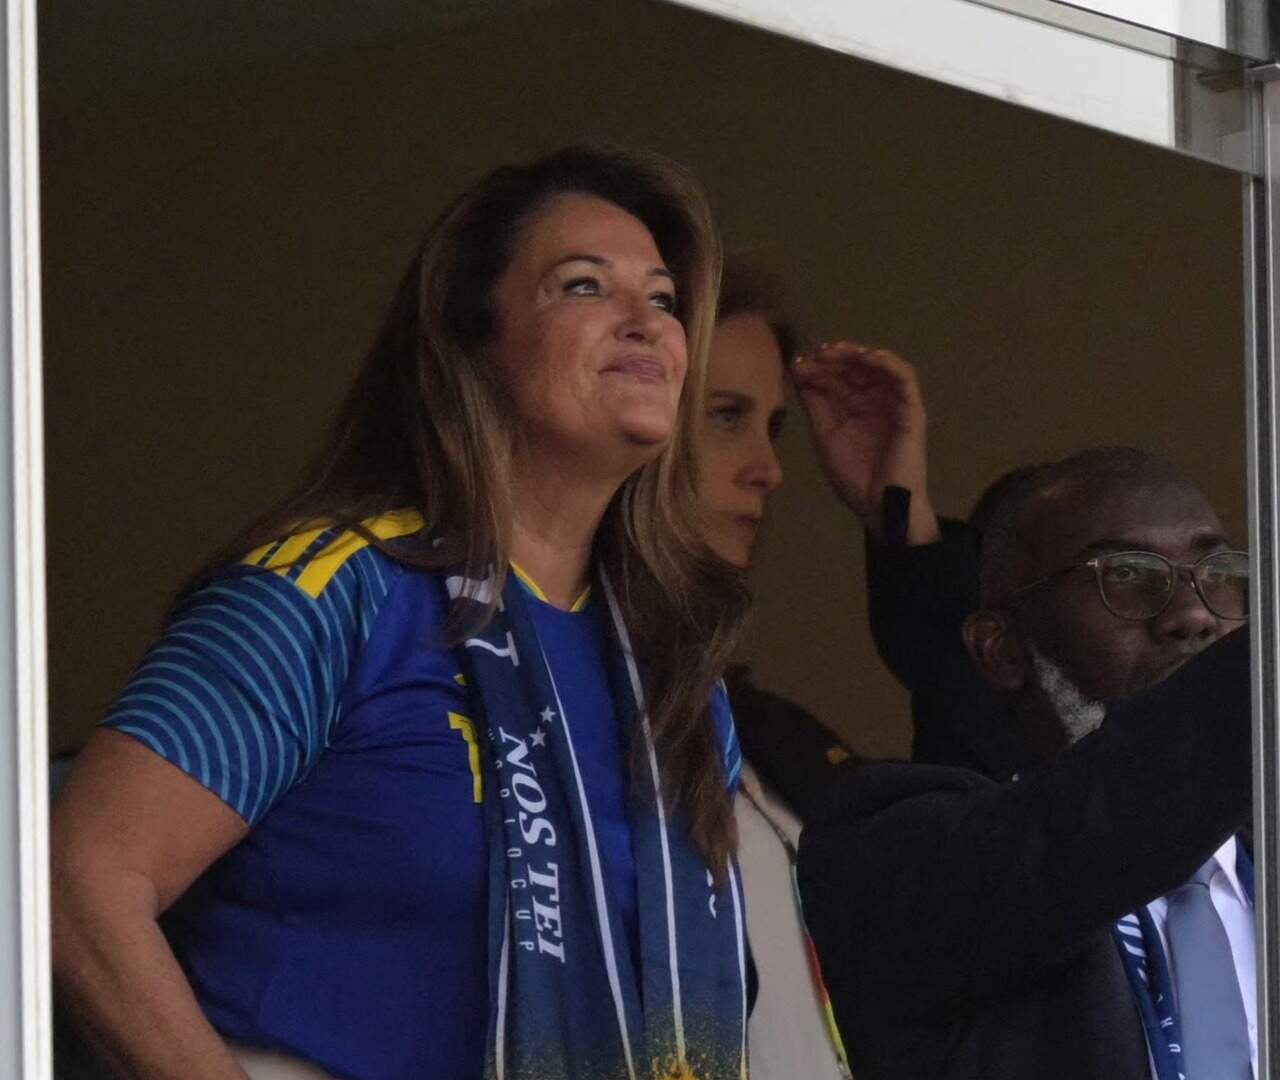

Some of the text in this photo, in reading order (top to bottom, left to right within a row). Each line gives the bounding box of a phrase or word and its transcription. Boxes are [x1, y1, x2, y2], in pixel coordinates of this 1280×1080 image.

[498, 726, 566, 964] NOS TEI
[510, 878, 536, 951] CUP
